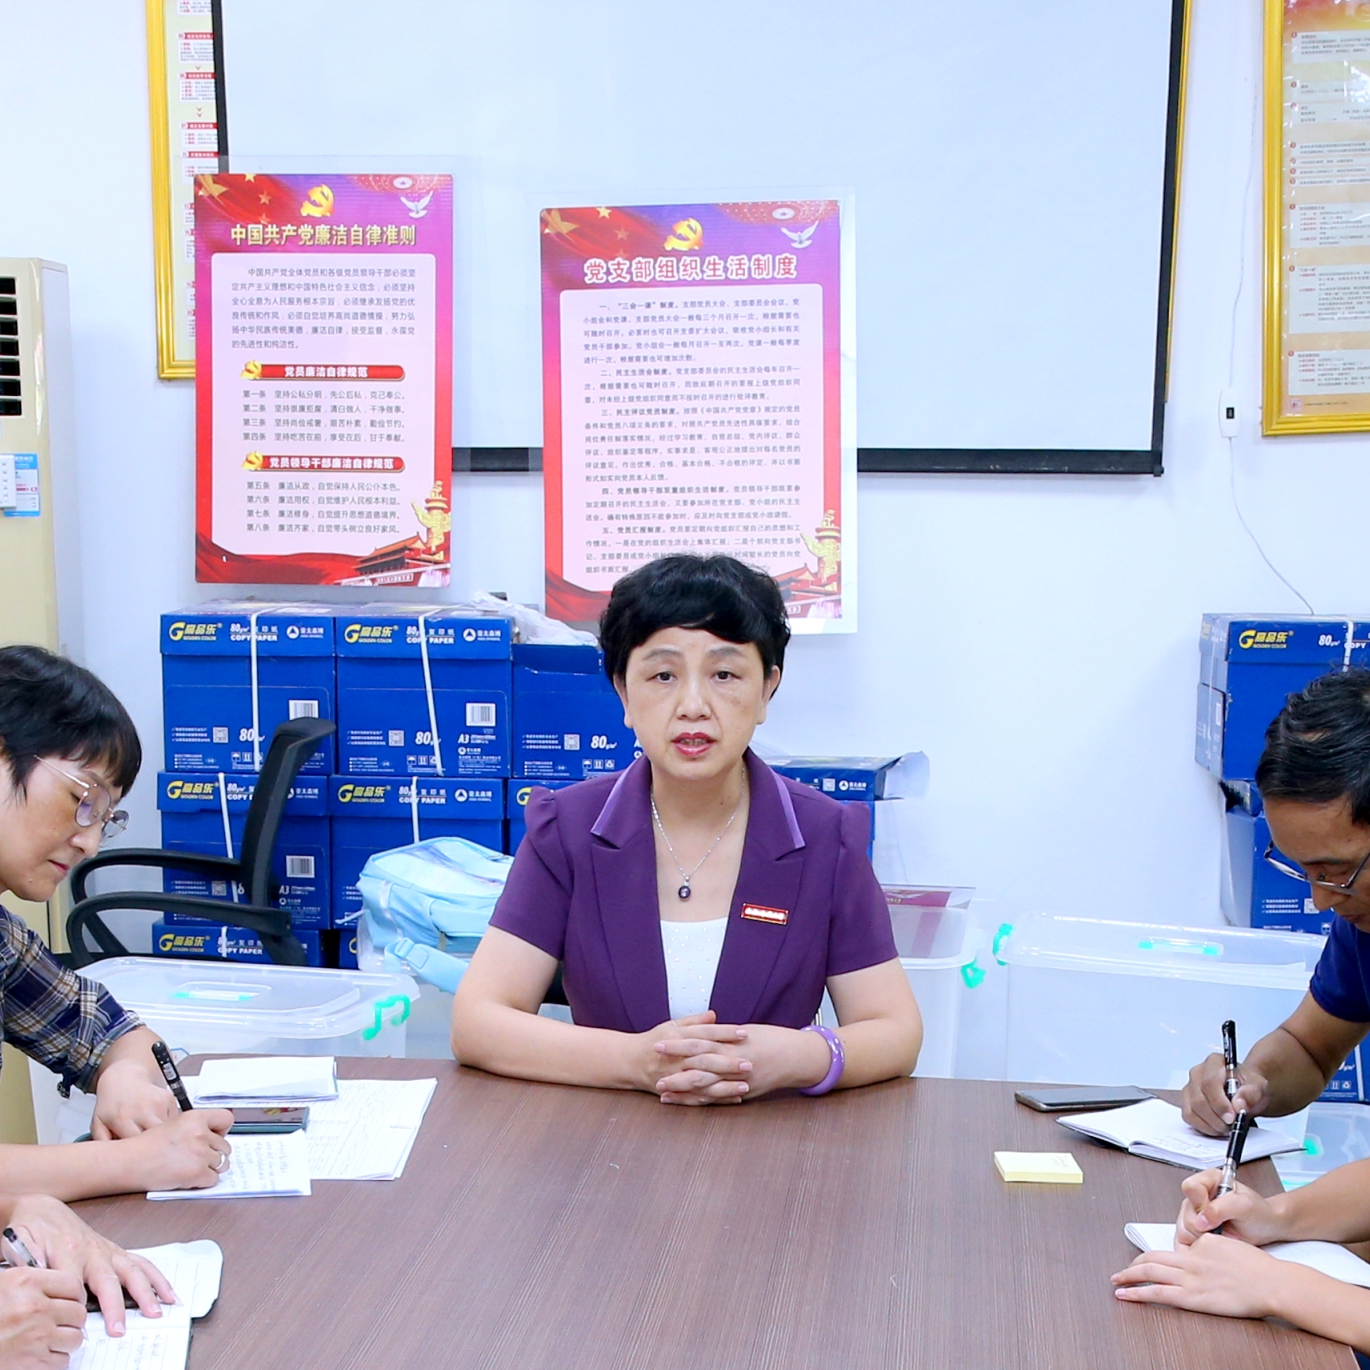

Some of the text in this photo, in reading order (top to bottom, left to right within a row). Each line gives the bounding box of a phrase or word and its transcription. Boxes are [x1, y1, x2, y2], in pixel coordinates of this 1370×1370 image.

[230, 224, 416, 246] 中国共产党廉洁自律准则
[583, 253, 798, 284] 党支部组织生活制度
[232, 340, 299, 349] 的先进性和纯洁性。
[284, 366, 368, 378] 党员廉洁自律规范
[243, 390, 267, 399] 第一条
[243, 404, 267, 413] 第二条
[243, 418, 267, 427] 第三条
[243, 433, 267, 442] 第四条
[269, 457, 394, 470] 党员领导干部廉洁自律规范
[246, 481, 270, 490] 第五条
[246, 495, 270, 504] 第六条
[246, 509, 270, 518] 第七条
[246, 523, 270, 532] 第八条
[185, 623, 217, 635] 高品乐
[360, 626, 392, 637] 高品乐
[1254, 631, 1288, 643] 高品乐
[458, 733, 470, 744] A3
[182, 783, 214, 794] 高品乐
[353, 786, 386, 797] 高品乐
